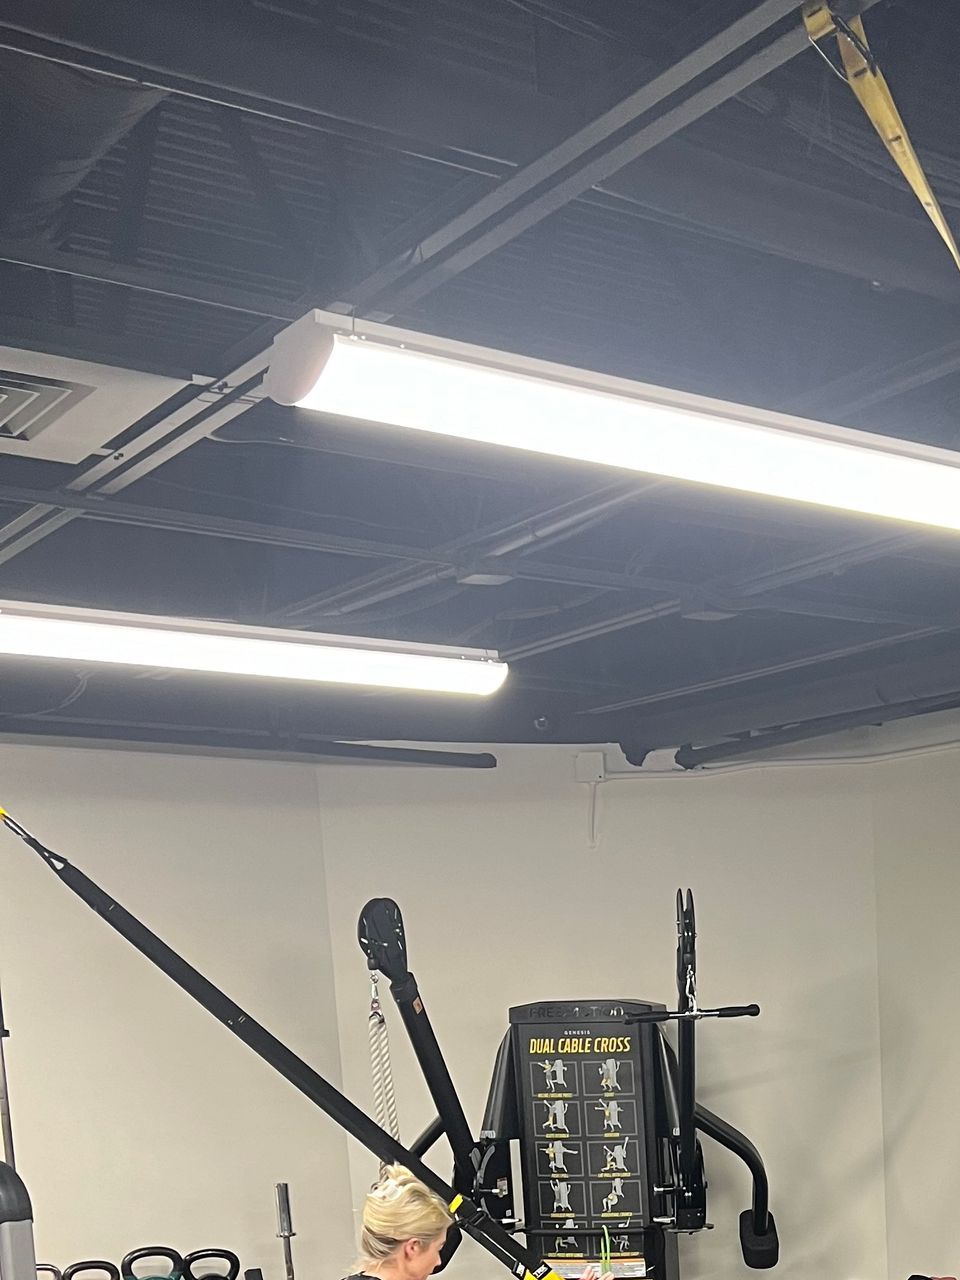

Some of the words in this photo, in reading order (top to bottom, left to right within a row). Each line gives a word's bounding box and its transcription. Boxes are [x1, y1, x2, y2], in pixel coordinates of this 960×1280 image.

[529, 1038, 556, 1054] DUAL
[557, 1037, 593, 1053] CABLE
[593, 1036, 631, 1053] CROSS
